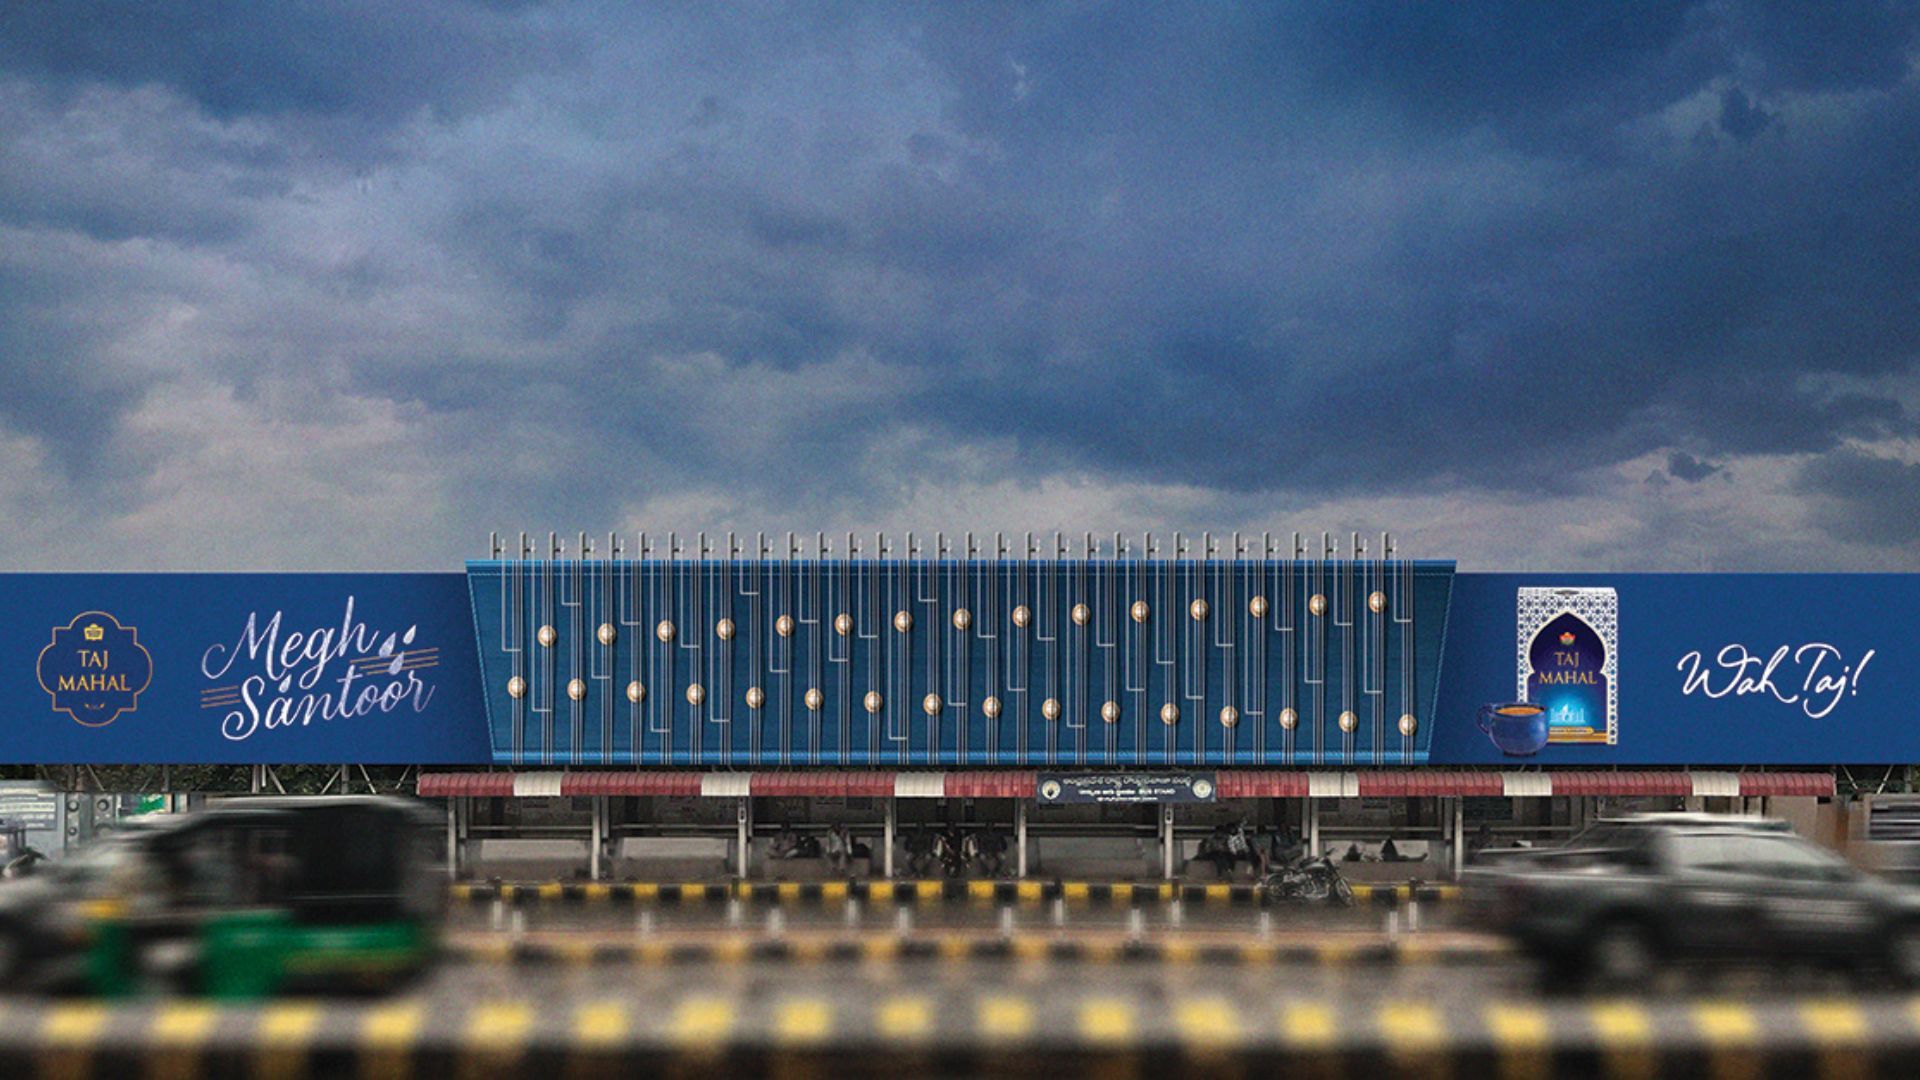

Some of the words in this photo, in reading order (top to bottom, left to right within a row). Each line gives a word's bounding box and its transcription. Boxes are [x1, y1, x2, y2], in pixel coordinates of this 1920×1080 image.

[201, 596, 379, 689] Megh
[77, 650, 109, 670] TAJ
[1554, 652, 1580, 668] TAJ
[58, 674, 132, 692] MAHAL
[1538, 671, 1598, 686] MAHAL
[1677, 643, 1798, 703] Wah
[1795, 643, 1875, 719] Taj!
[222, 664, 437, 741] Santoor
